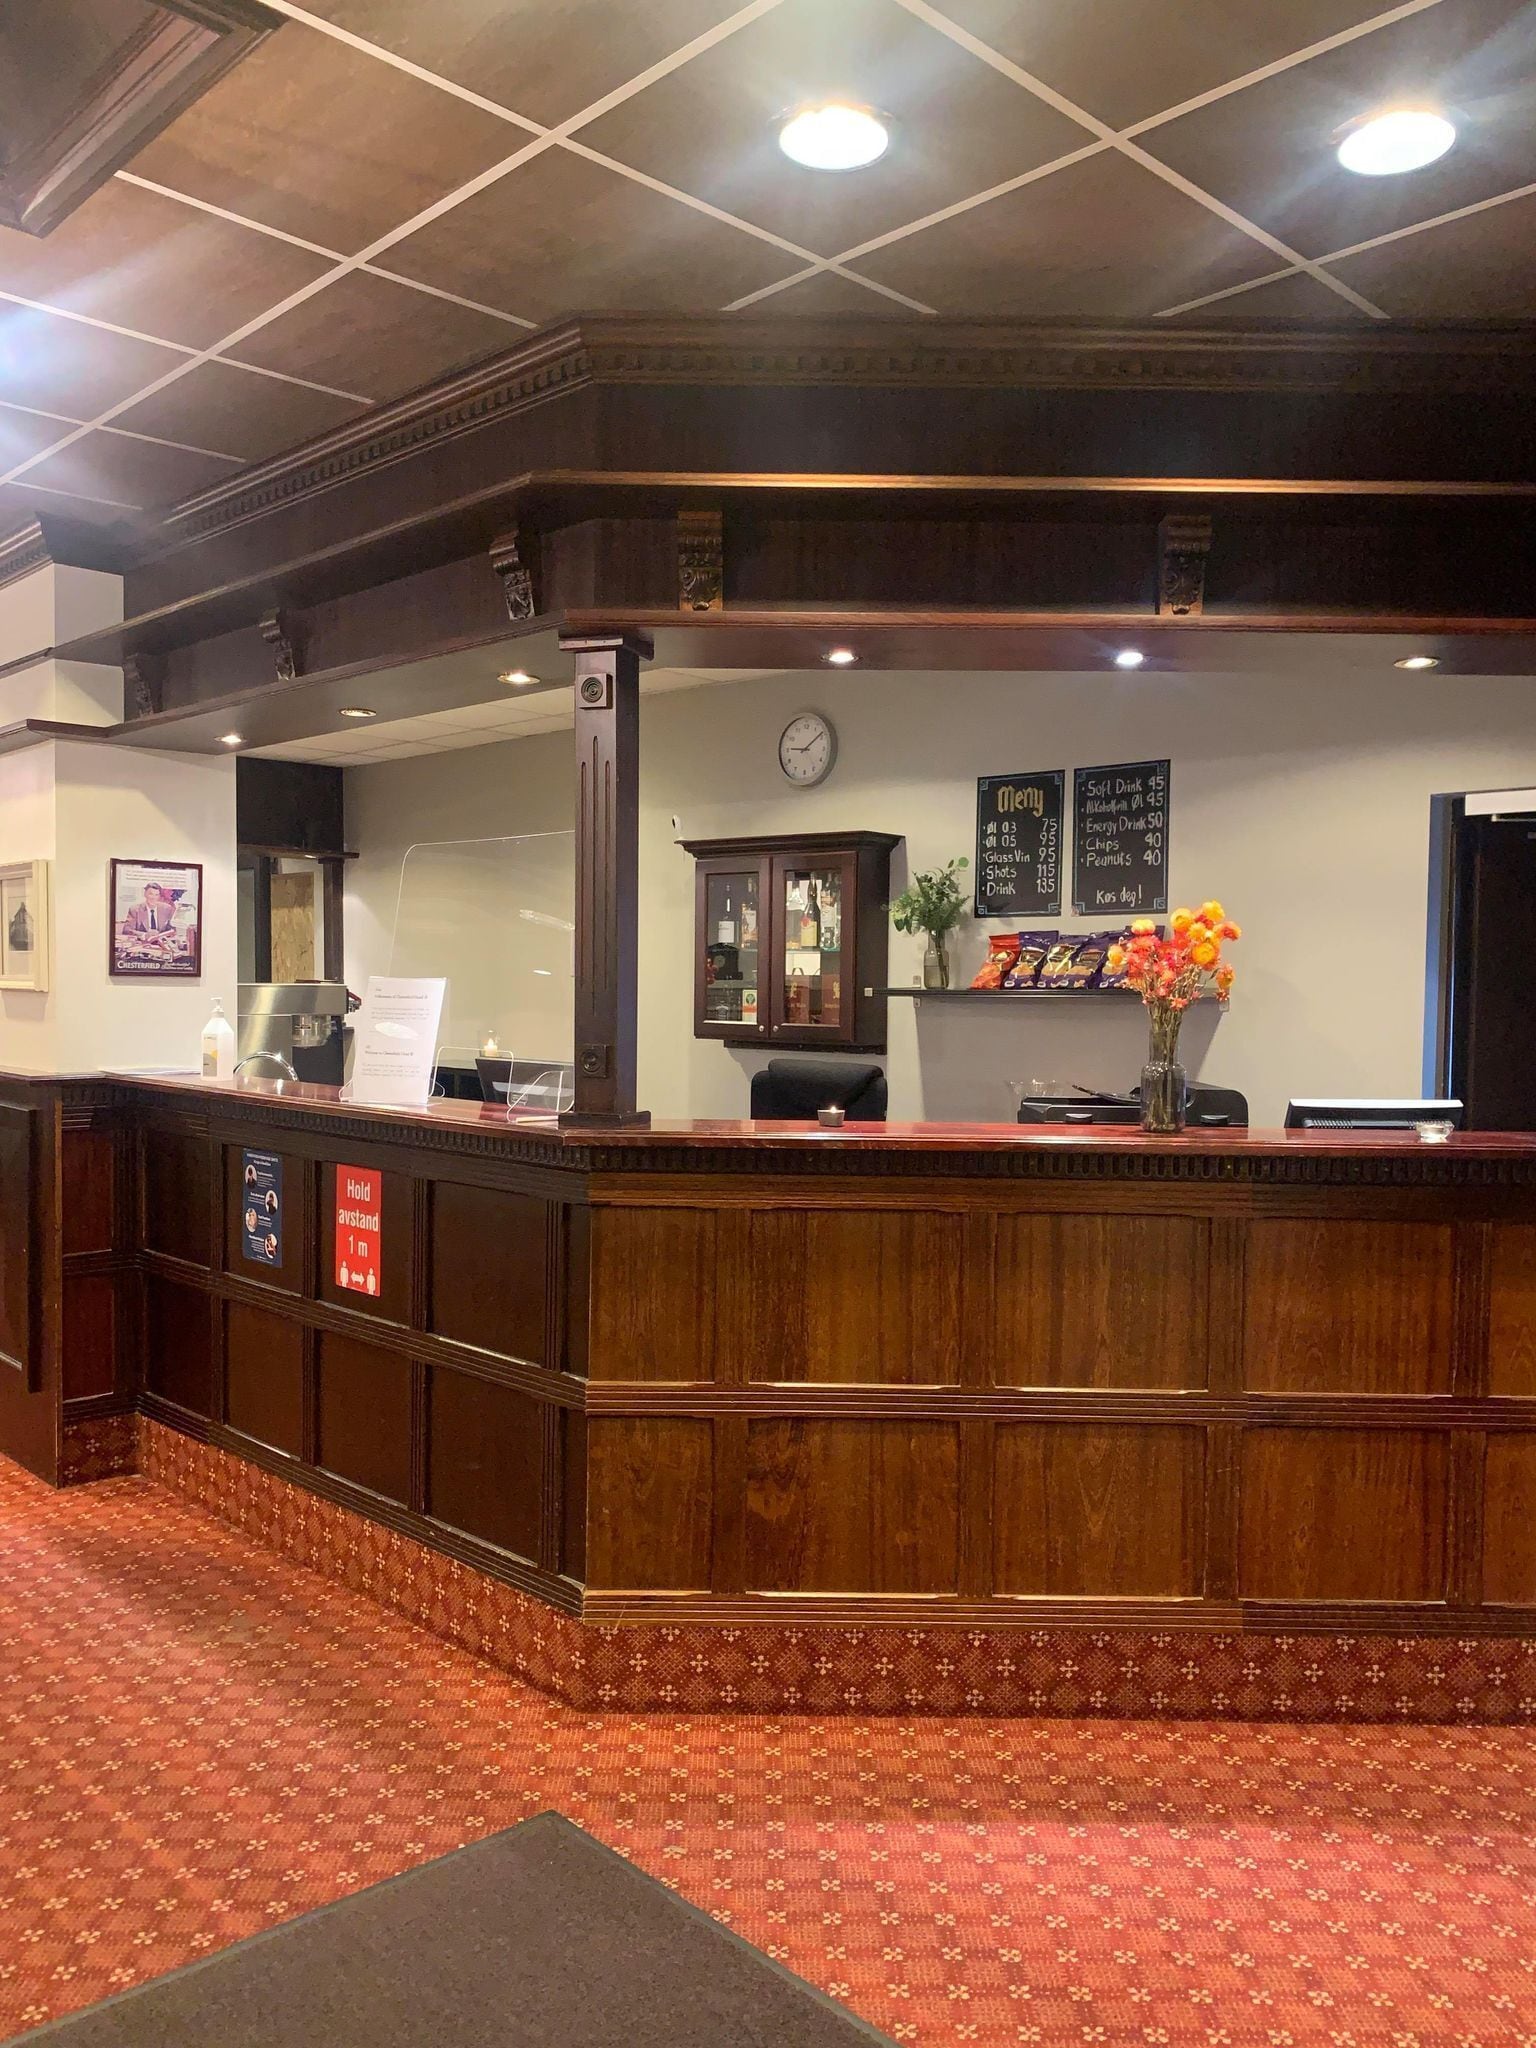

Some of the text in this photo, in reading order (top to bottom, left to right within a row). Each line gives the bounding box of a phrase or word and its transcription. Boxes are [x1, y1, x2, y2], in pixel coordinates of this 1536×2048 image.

[1087, 780, 1111, 797] Soft
[1148, 776, 1164, 790] 45
[997, 785, 1044, 817] Meny
[1147, 792, 1163, 806] 45
[1042, 818, 1057, 831] 75
[1087, 818, 1116, 835] Energy
[1148, 811, 1163, 828] 50
[1040, 832, 1056, 845] 95
[1086, 832, 1161, 852] Chips 40
[985, 847, 1056, 863] Glass Vin 95
[1087, 850, 1161, 867] Peanuts 40
[986, 863, 1055, 879] Shots 115
[1036, 878, 1055, 893] 135
[347, 1178, 371, 1201] Hold
[338, 1208, 379, 1232] avstand
[348, 1234, 368, 1257] 1 m
